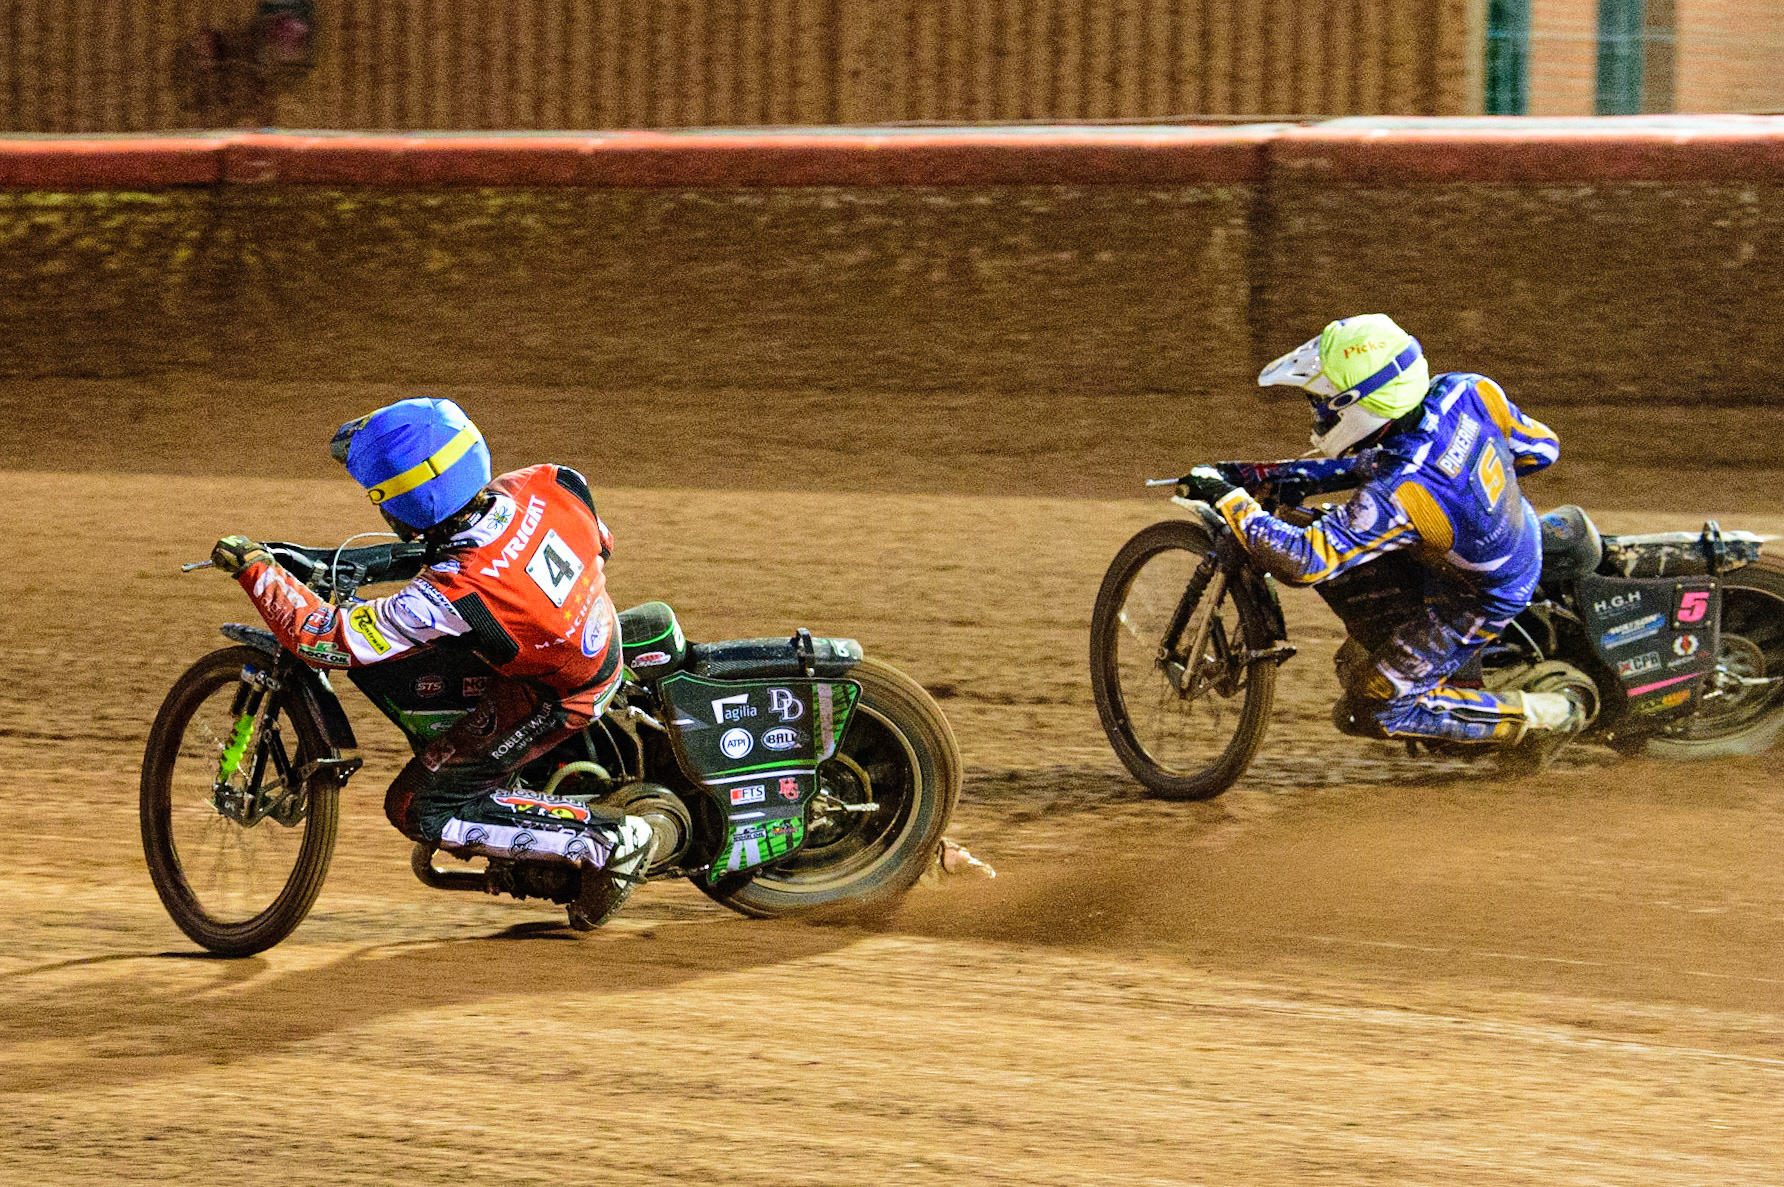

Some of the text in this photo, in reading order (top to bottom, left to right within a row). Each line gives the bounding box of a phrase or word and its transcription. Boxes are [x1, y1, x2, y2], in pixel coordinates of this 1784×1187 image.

[1478, 441, 1506, 508] 5
[480, 494, 546, 578] WRIGHT
[543, 544, 575, 587] 4
[1677, 592, 1710, 622] 5
[724, 705, 758, 722] agilia
[726, 737, 746, 749] ATPI
[742, 786, 763, 799] FTS
